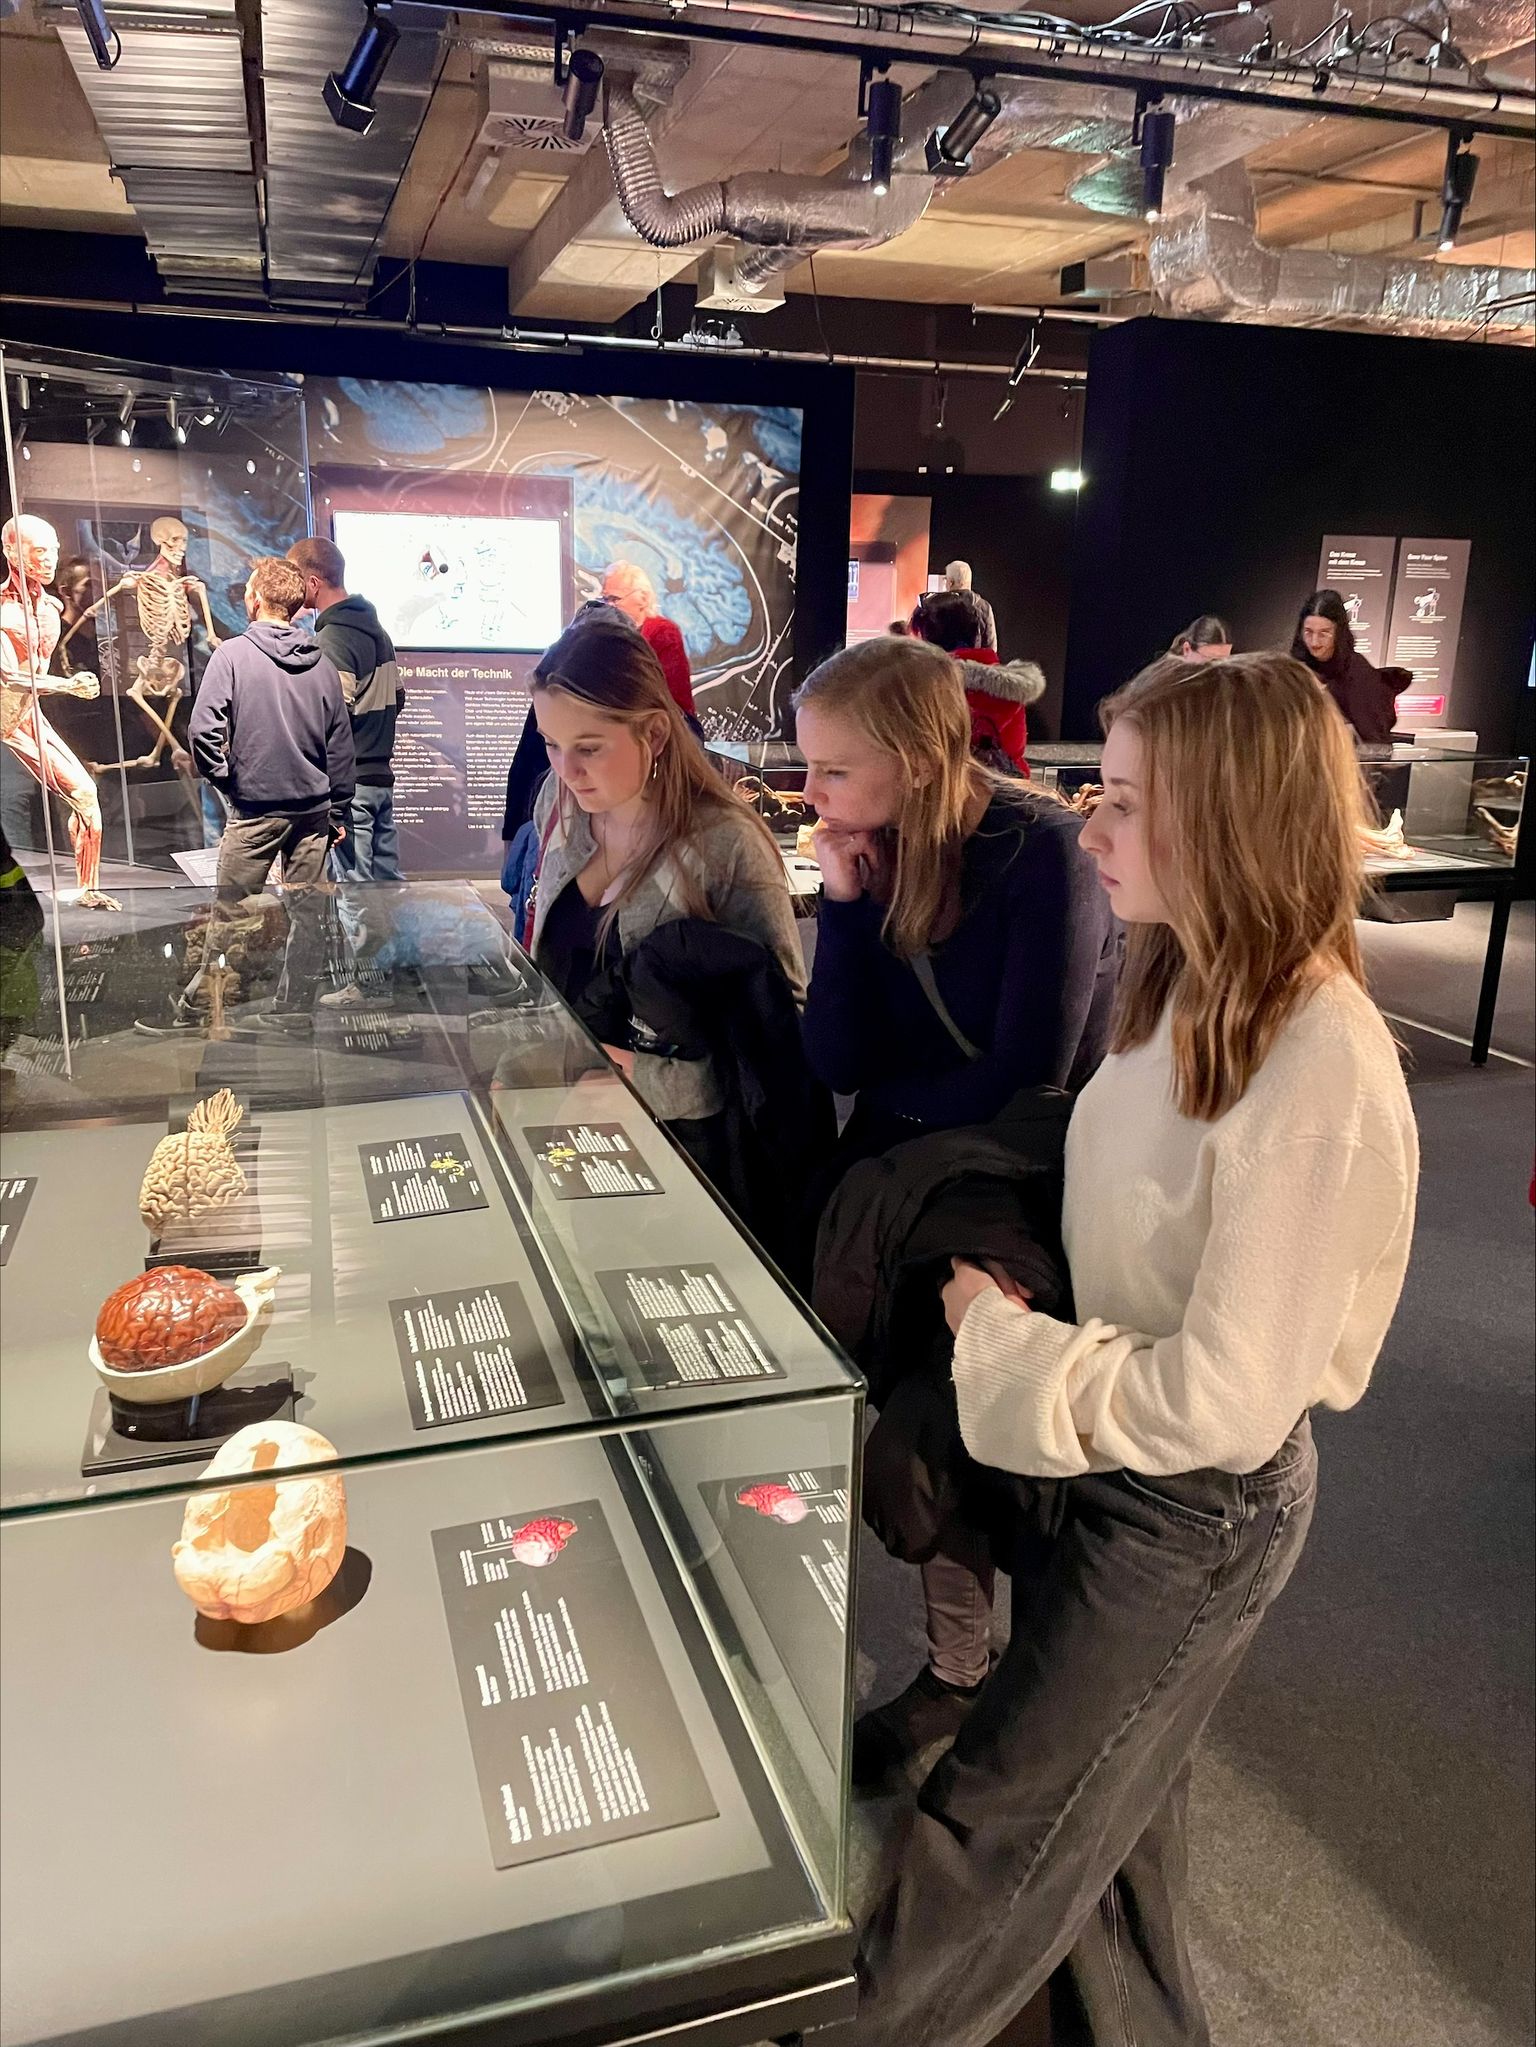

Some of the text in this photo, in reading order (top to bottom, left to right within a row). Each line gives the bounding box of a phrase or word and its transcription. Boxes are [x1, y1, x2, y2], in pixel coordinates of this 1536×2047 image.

[416, 667, 449, 678] Macht
[451, 668, 470, 678] der
[471, 668, 513, 679] Technik
